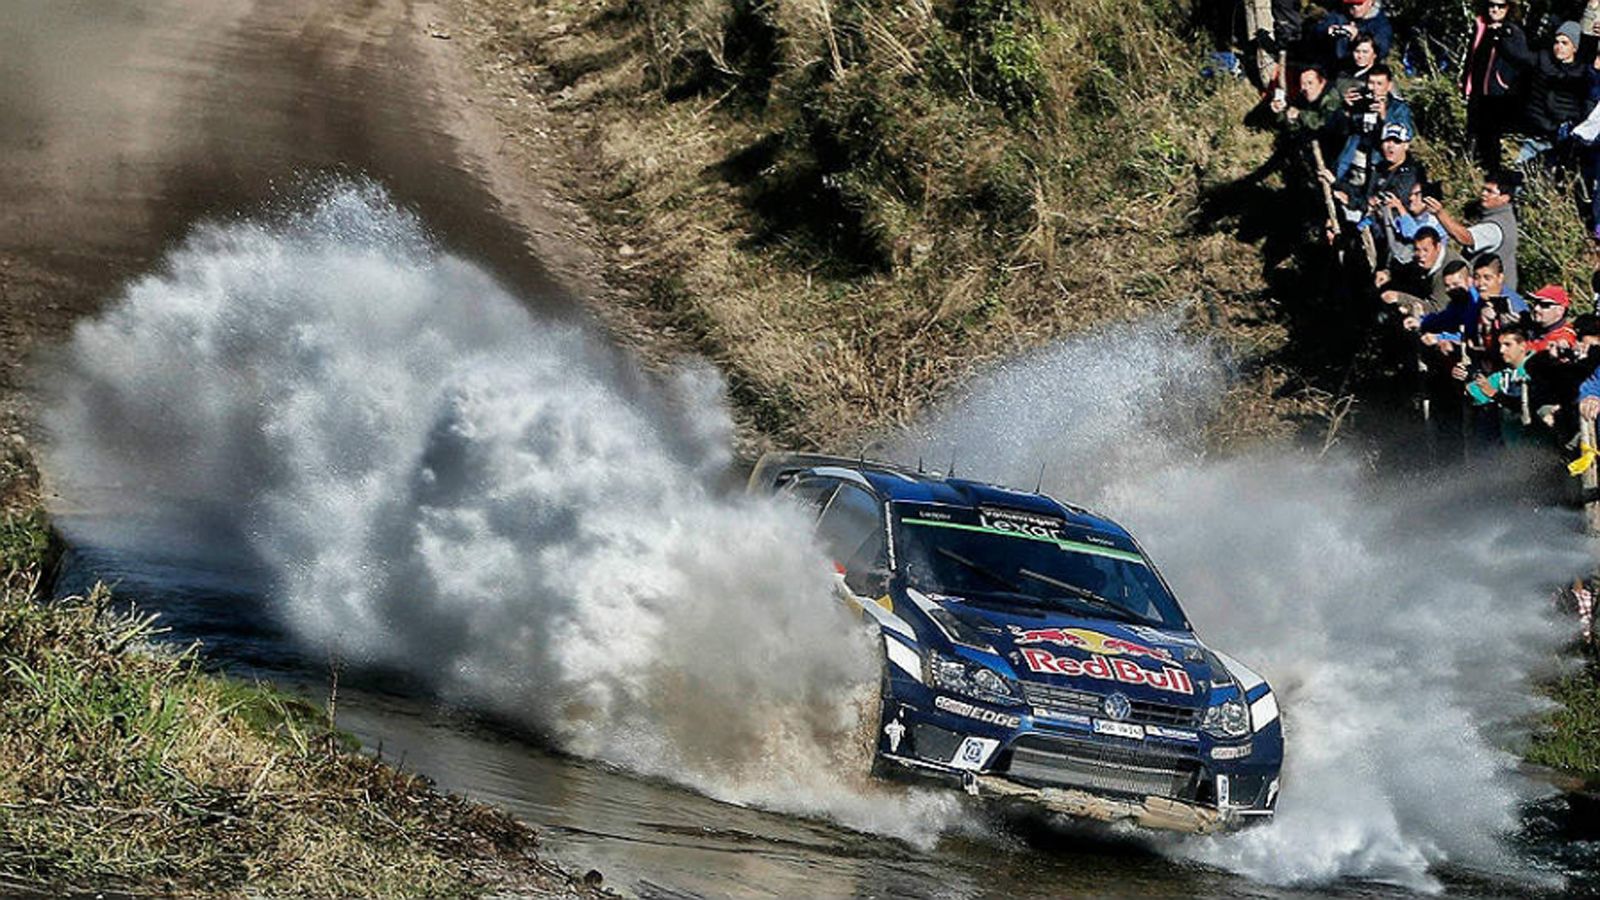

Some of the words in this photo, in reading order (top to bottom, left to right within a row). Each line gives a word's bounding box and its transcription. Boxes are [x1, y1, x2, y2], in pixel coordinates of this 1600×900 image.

[980, 515, 1060, 541] Lexar
[1020, 648, 1114, 681] Red
[1109, 656, 1194, 695] Bull
[970, 707, 1021, 729] EDGE
